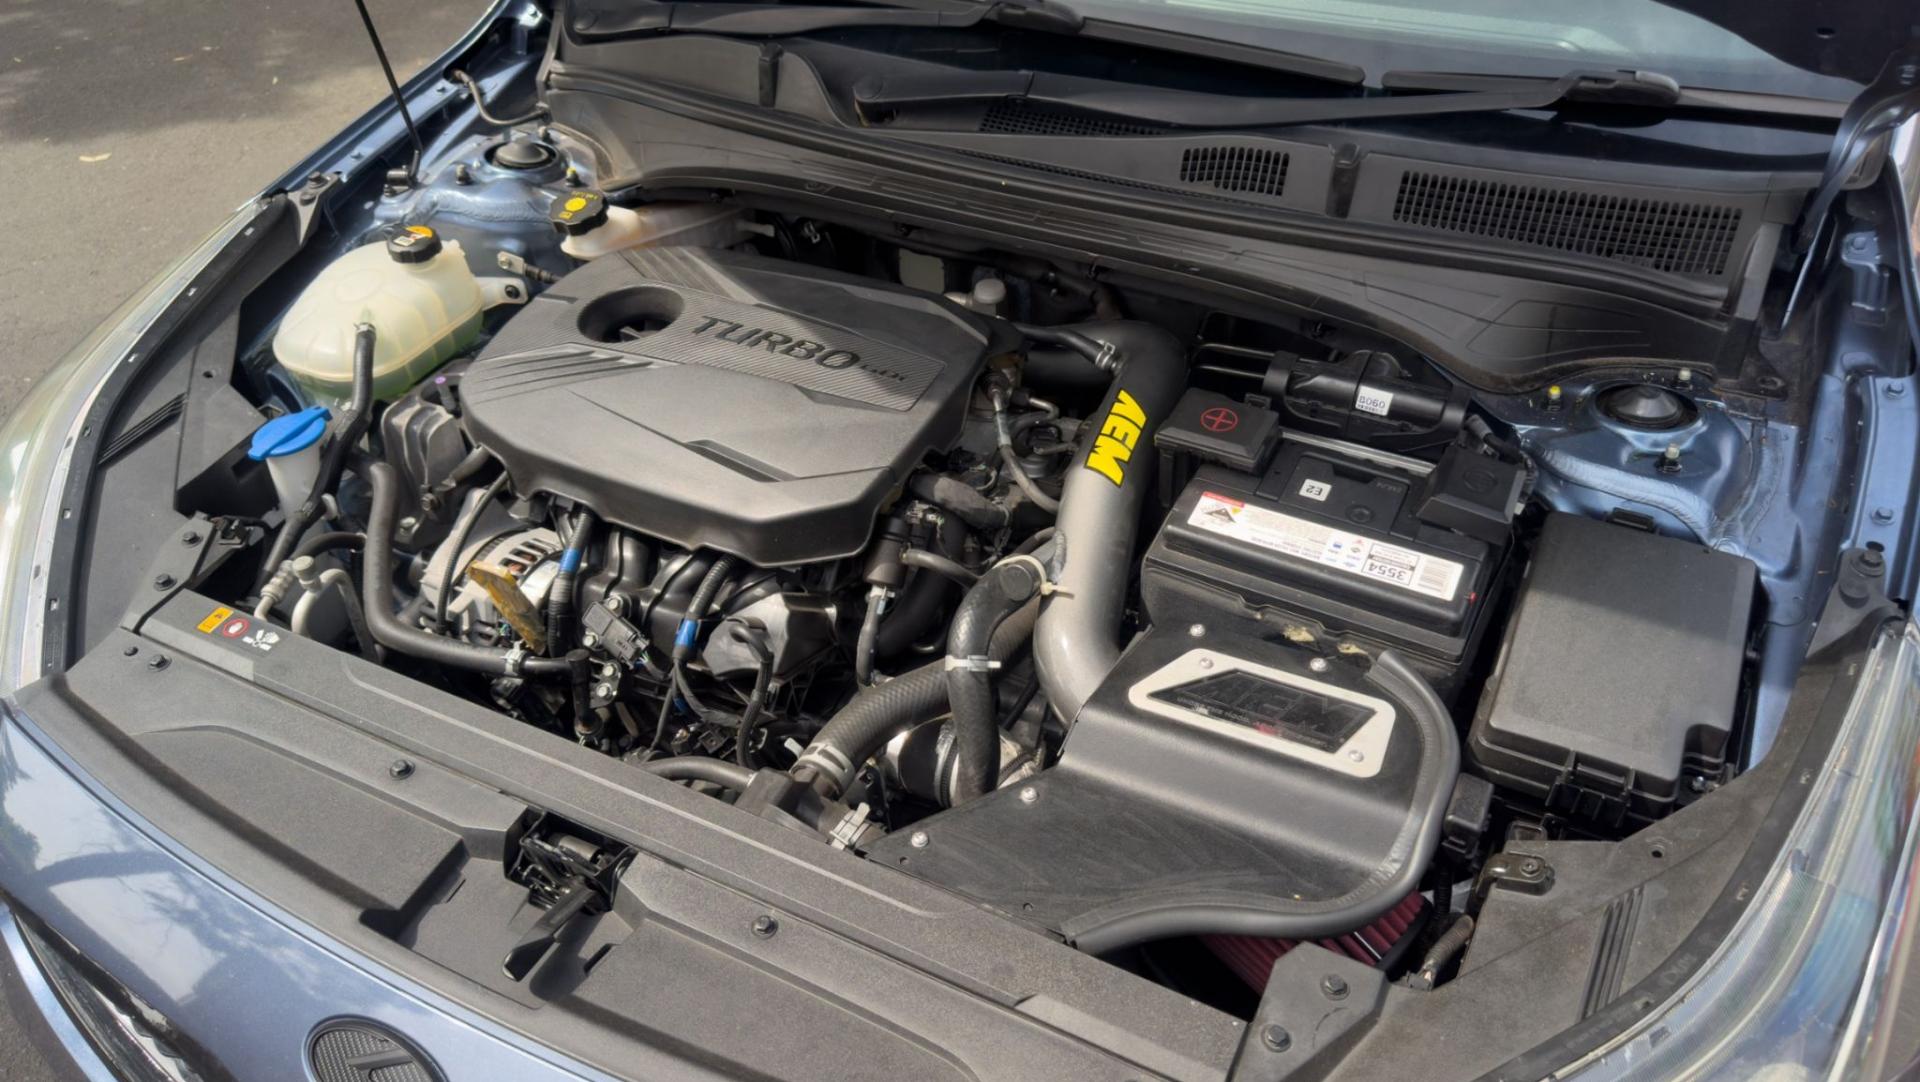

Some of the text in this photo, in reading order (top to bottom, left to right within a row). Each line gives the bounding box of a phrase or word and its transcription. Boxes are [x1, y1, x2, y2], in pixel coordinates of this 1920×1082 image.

[691, 315, 860, 369] TURBO
[1084, 388, 1147, 488] AEM
[1306, 483, 1323, 497] E2
[1368, 562, 1406, 581] 3554
